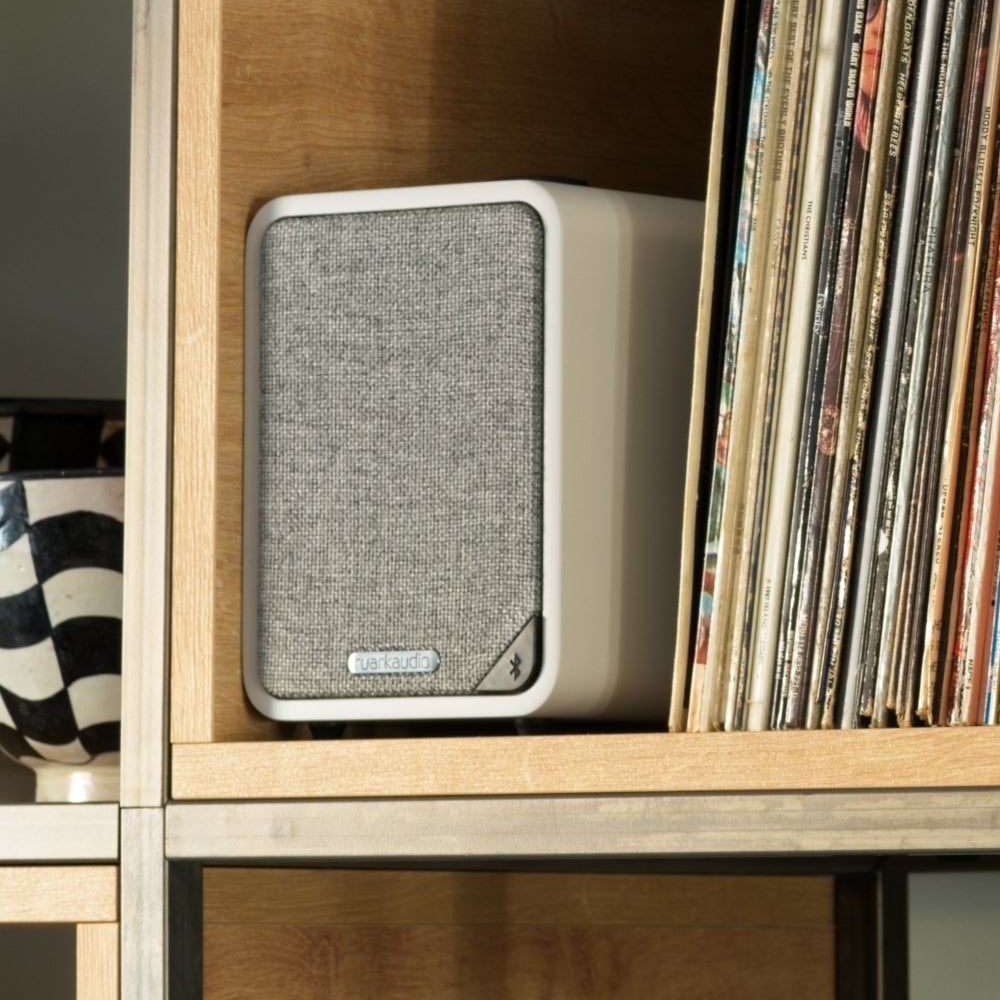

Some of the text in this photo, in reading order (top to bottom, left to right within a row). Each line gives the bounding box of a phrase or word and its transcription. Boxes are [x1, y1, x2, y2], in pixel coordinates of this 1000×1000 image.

[852, 10, 863, 34] ISAAK
[943, 0, 955, 34] FAGEN
[786, 21, 797, 46] BEST
[899, 22, 913, 64] GREATS
[784, 48, 794, 63] OF
[849, 41, 860, 66] HEART
[782, 65, 792, 85] THE
[846, 68, 857, 98] SHAPED
[933, 62, 947, 111] NIGHTFLY
[777, 87, 790, 125] EVERLY
[843, 99, 854, 127] WORLD
[979, 106, 991, 140] MOODY
[800, 200, 813, 260] THE CHRISTIANS
[922, 226, 937, 294] PHAEDRA
[355, 652, 430, 672] ruarkaudio
